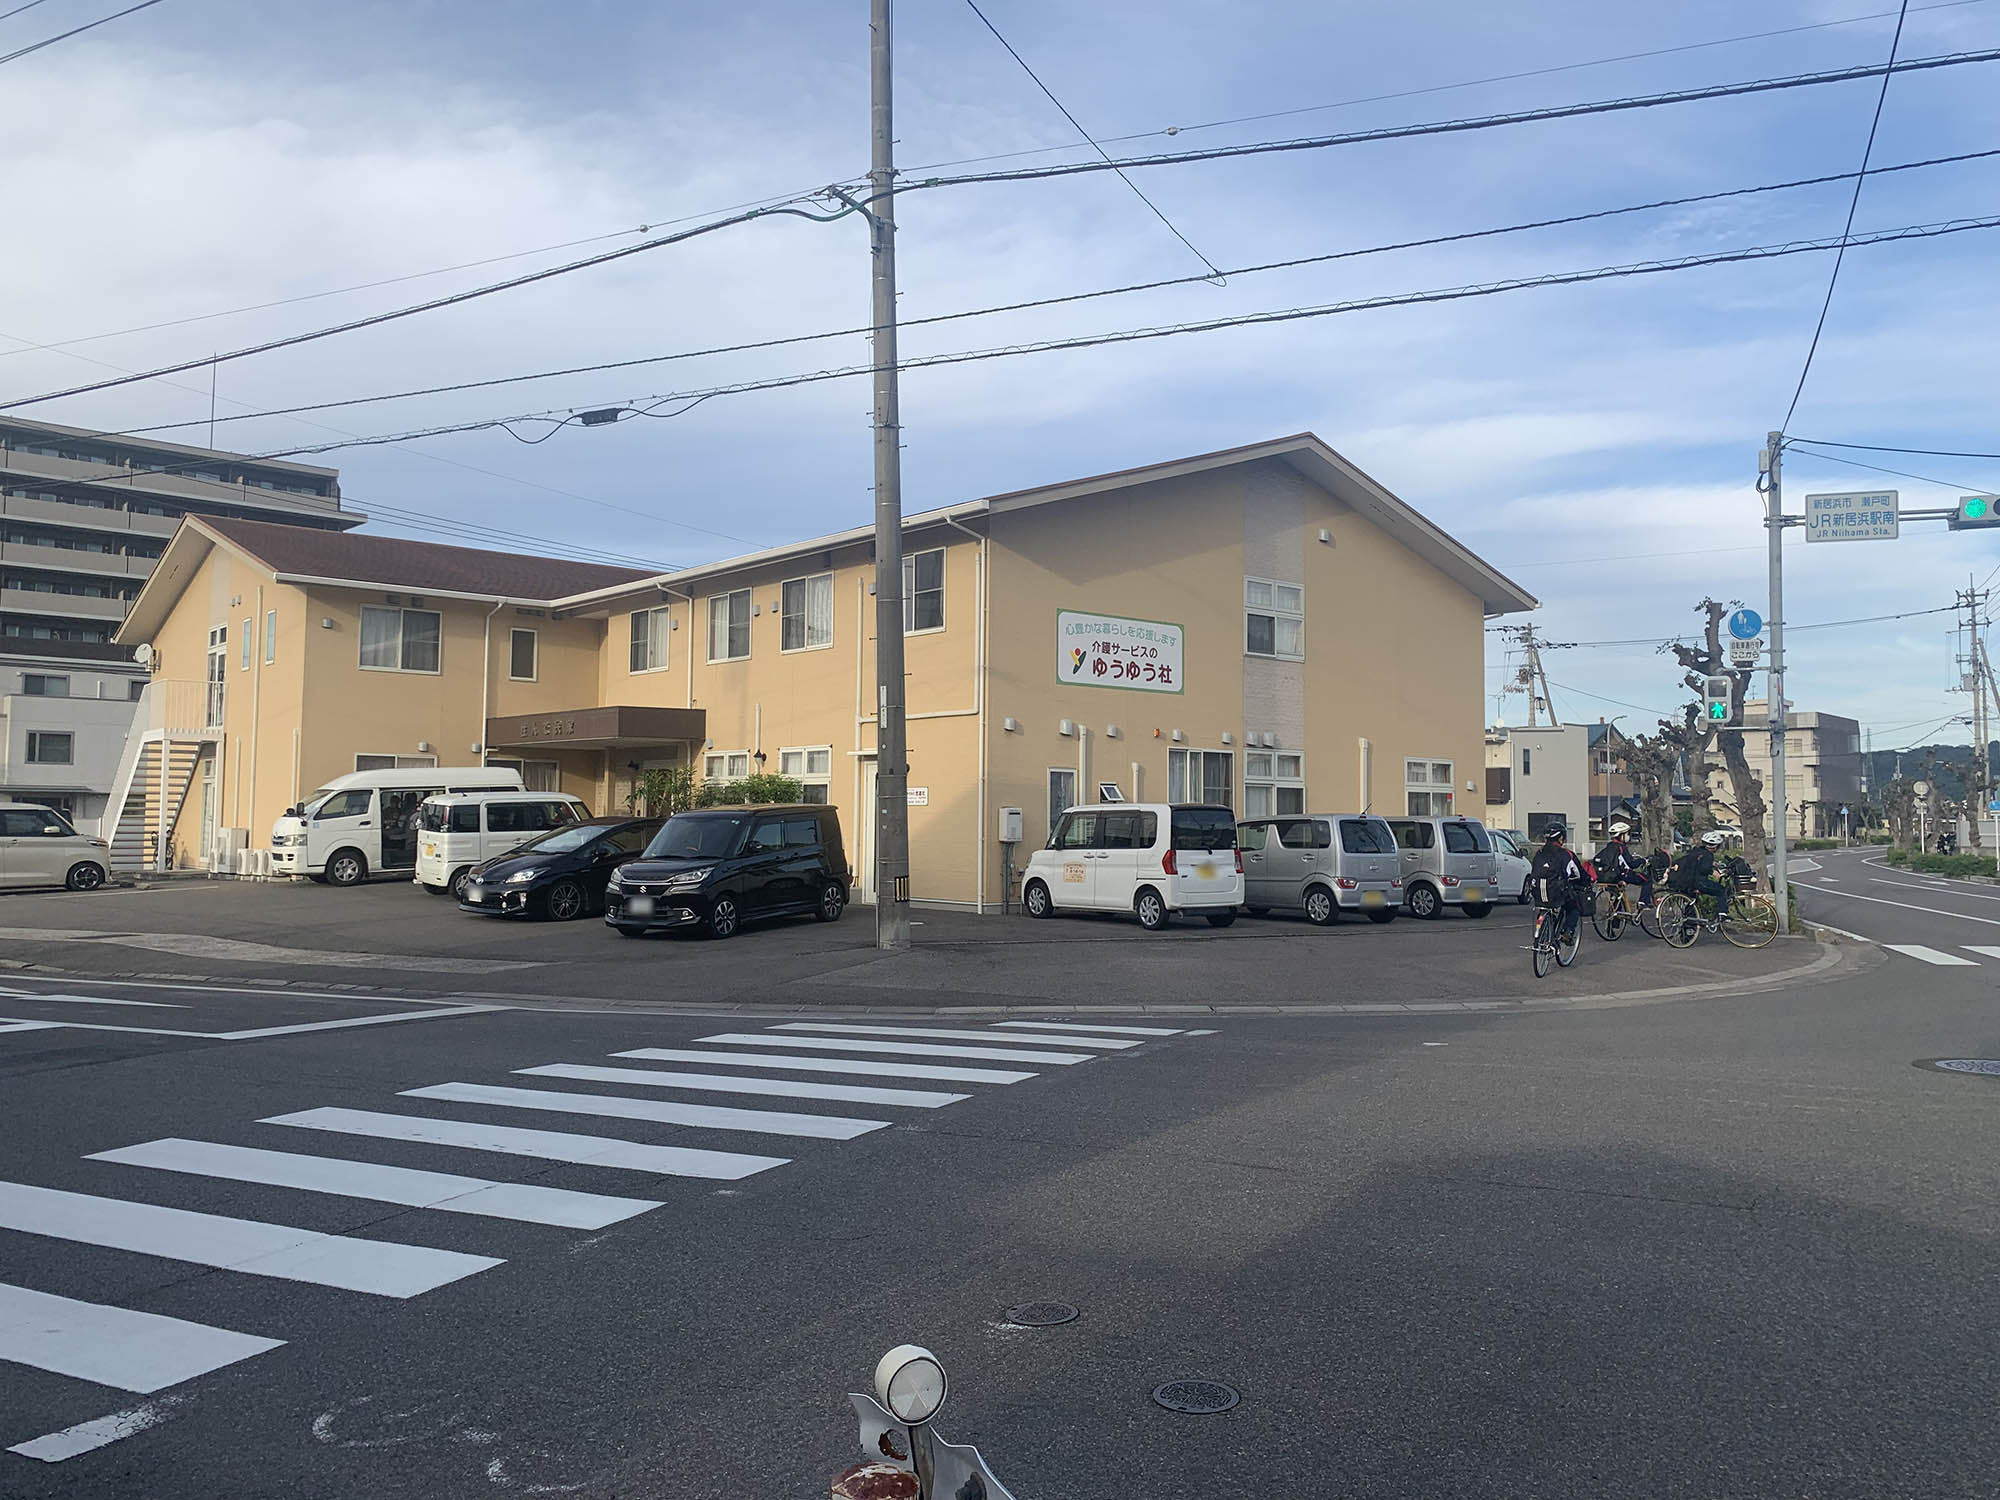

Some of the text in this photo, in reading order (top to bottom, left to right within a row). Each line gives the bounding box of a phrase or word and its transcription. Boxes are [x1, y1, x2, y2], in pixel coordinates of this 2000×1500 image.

[1813, 495, 1890, 510] 新居浜市 瀬戸町
[1809, 511, 1894, 529] JR新居浜駅南
[1817, 527, 1891, 538] JR Niihama Sta.
[1065, 622, 1177, 647] 心豊かな暮らしを応援します
[1091, 640, 1158, 659] 介護サービスの
[1731, 650, 1759, 659] ここから
[1092, 657, 1173, 684] ゆうゆう社
